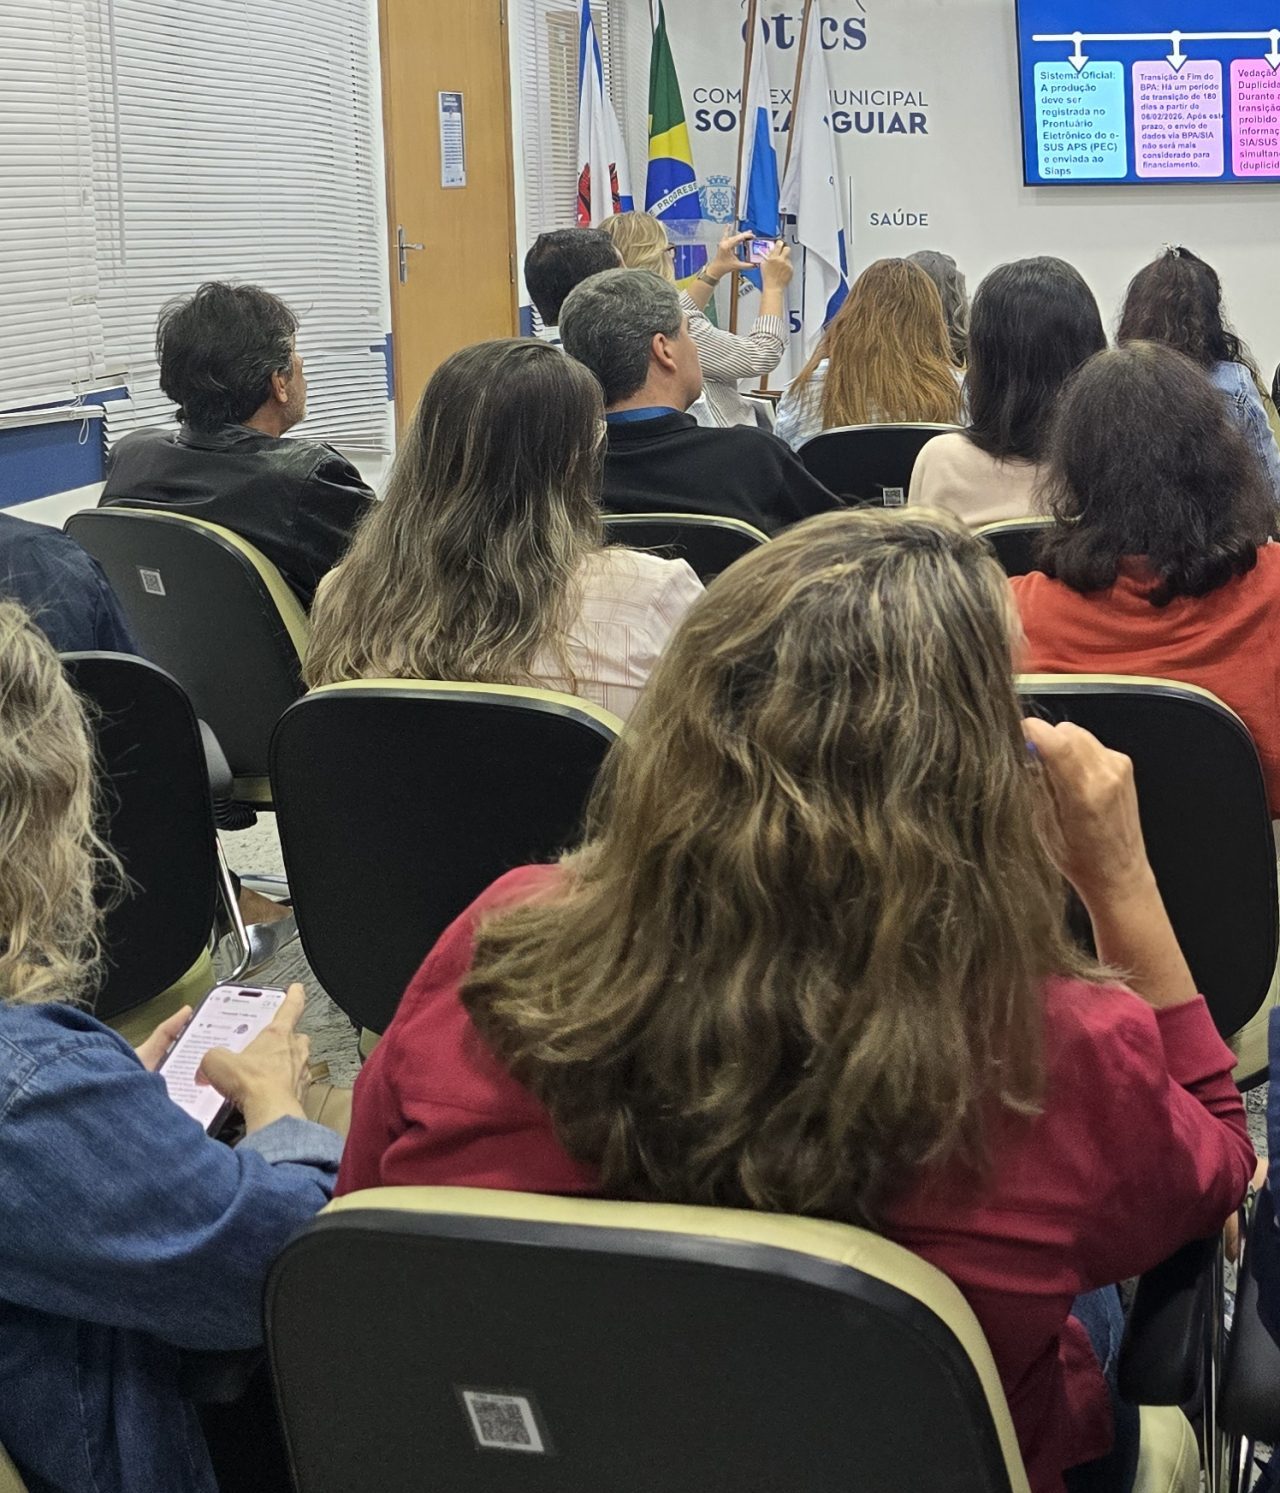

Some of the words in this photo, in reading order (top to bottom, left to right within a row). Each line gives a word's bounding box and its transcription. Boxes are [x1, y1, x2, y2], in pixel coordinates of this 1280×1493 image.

[742, 13, 866, 50] otcs
[1051, 84, 1096, 93] produção
[829, 90, 928, 107] UNICIPAL
[824, 111, 928, 134] GUIAR
[1044, 143, 1064, 151] SUS
[1067, 143, 1087, 151] APS
[1090, 143, 1117, 152] (PEC)
[1045, 167, 1071, 176] Siaps
[870, 208, 929, 227] SAÚDE
